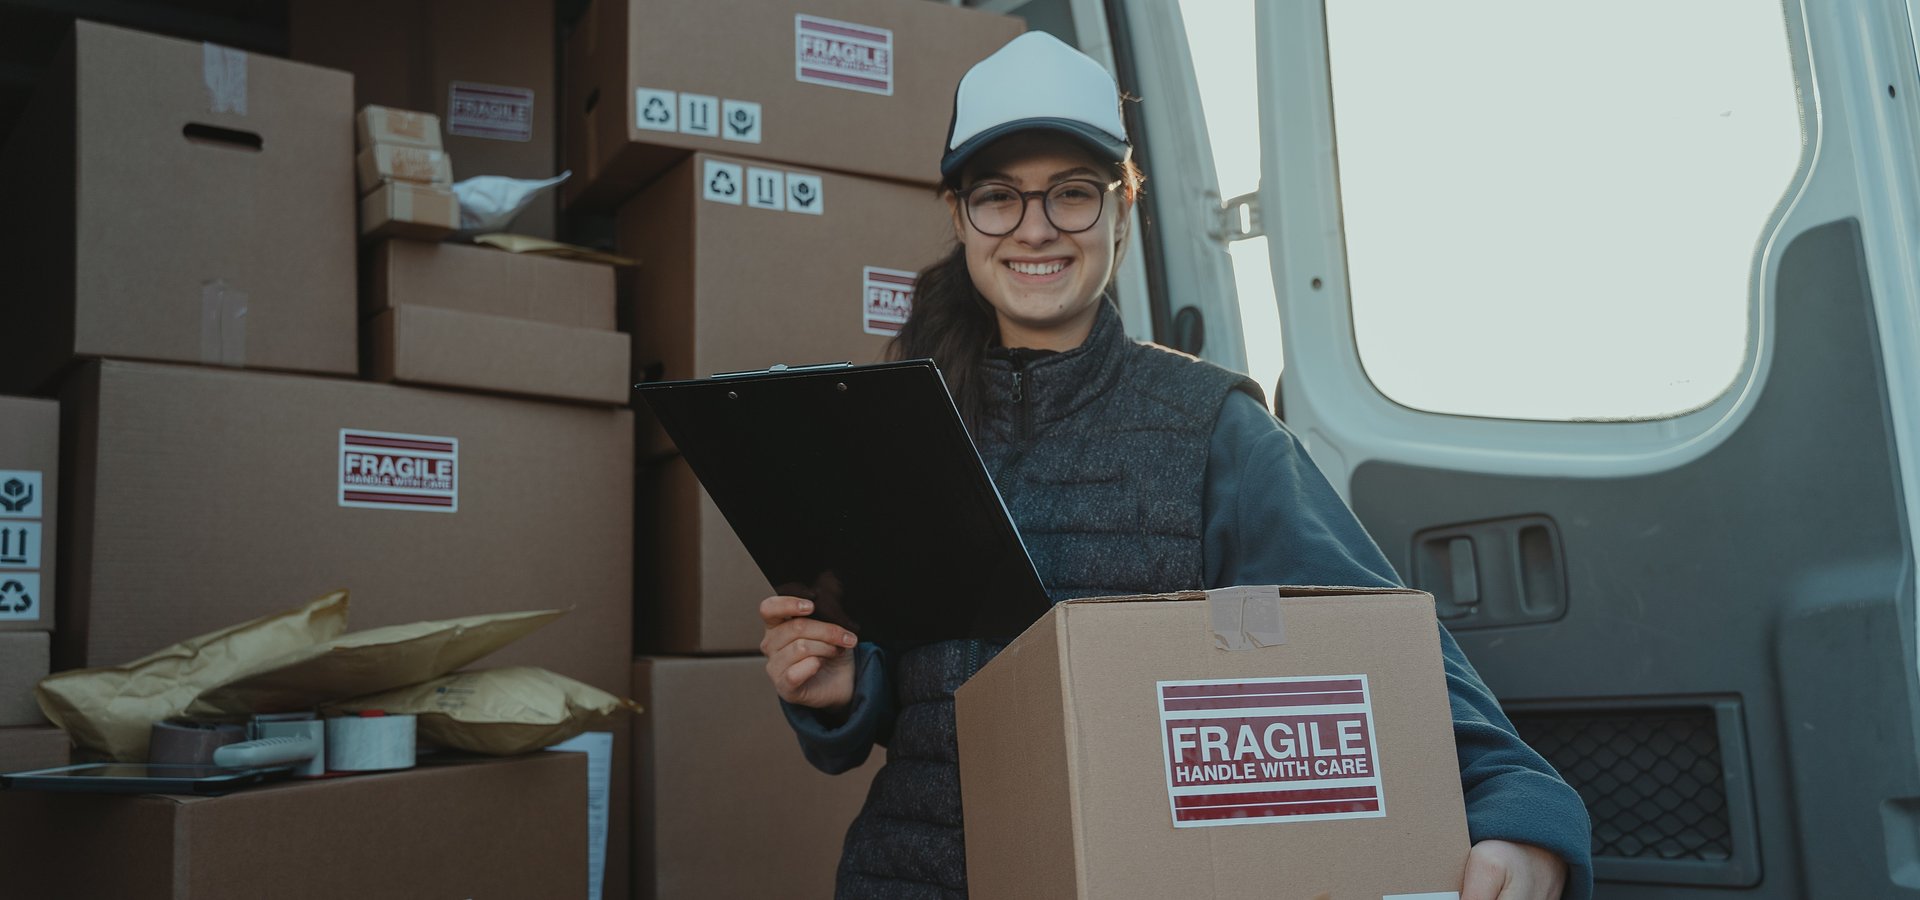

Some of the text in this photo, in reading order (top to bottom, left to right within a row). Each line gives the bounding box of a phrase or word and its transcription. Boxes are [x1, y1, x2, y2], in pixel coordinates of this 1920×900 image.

[801, 36, 887, 67] FRAGILE
[346, 453, 451, 480] FRAGILE
[1171, 720, 1366, 763] FRAGILE
[1176, 758, 1368, 782] HANDLE WITH CARE
